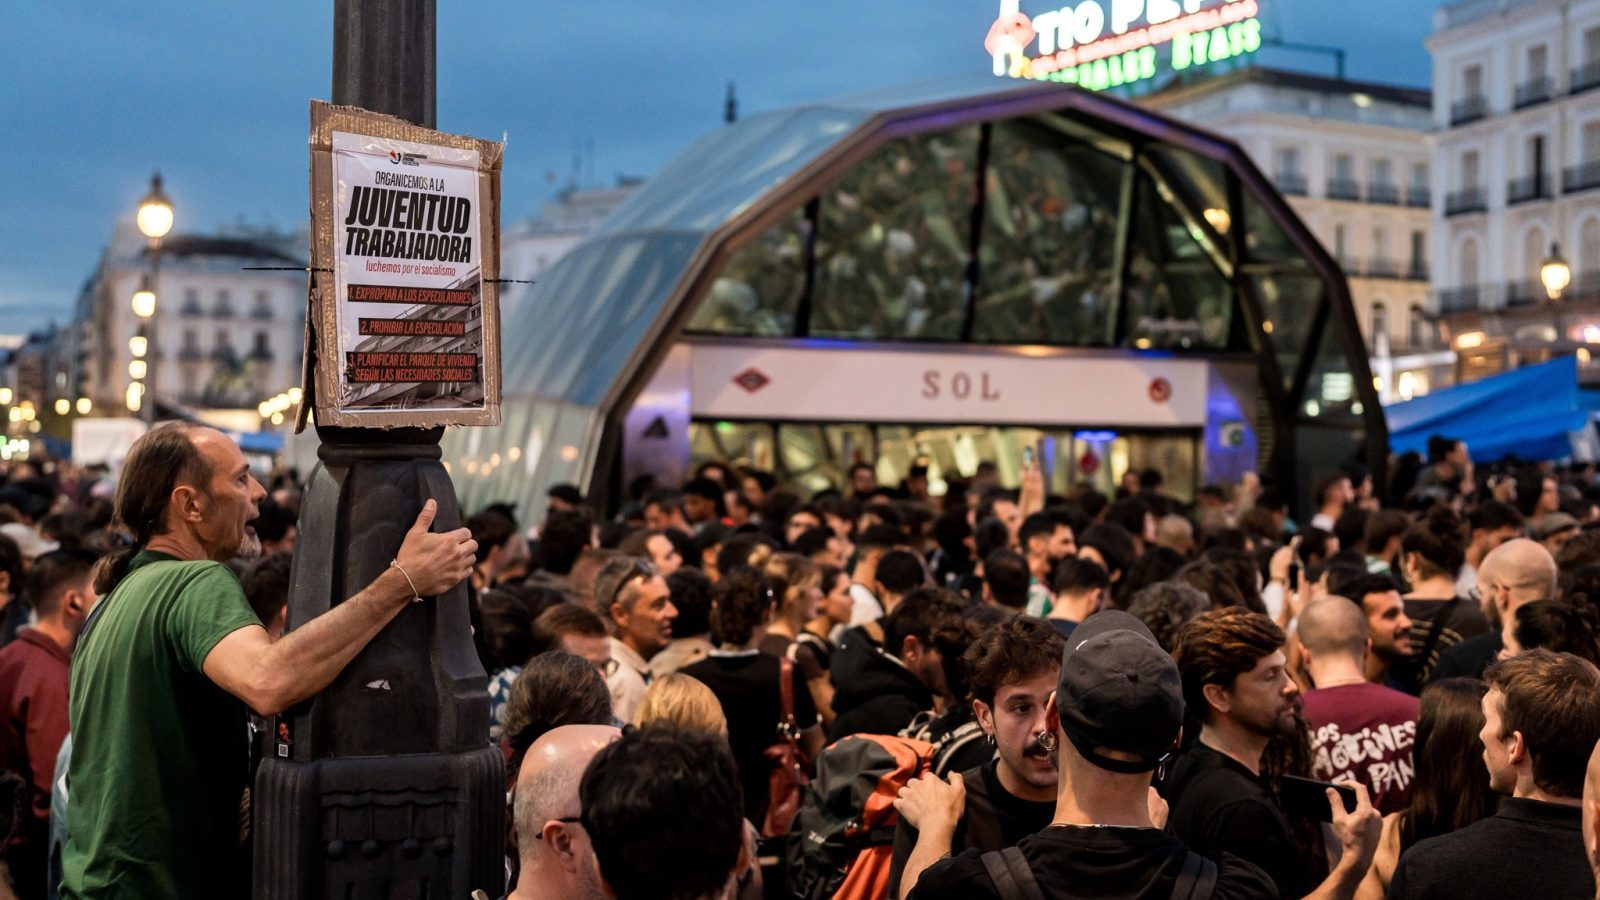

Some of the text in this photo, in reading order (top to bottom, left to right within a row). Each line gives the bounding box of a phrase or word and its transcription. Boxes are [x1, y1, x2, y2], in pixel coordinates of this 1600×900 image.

[1111, 0, 1238, 34] PE
[375, 171, 445, 192] ORGANICEMOS A LA
[345, 186, 471, 234] JUVENTUD
[345, 227, 472, 263] TRABAJADORA
[366, 260, 456, 277] luchemos por el socialismo
[355, 287, 397, 300] EXPROPIAR
[403, 289, 417, 301] LOS
[419, 289, 471, 304] ESPECULADORES
[361, 321, 368, 333] 2.
[369, 321, 404, 334] PROHIBIR
[404, 322, 415, 334] LA
[349, 353, 476, 367] 3. PLANIFICAR EL PARQUE DE VIVIENDA
[380, 368, 394, 381] LAS
[395, 368, 441, 381] NECESIDADES
[441, 368, 473, 381] SOCIALES
[922, 368, 1001, 402] SOL
